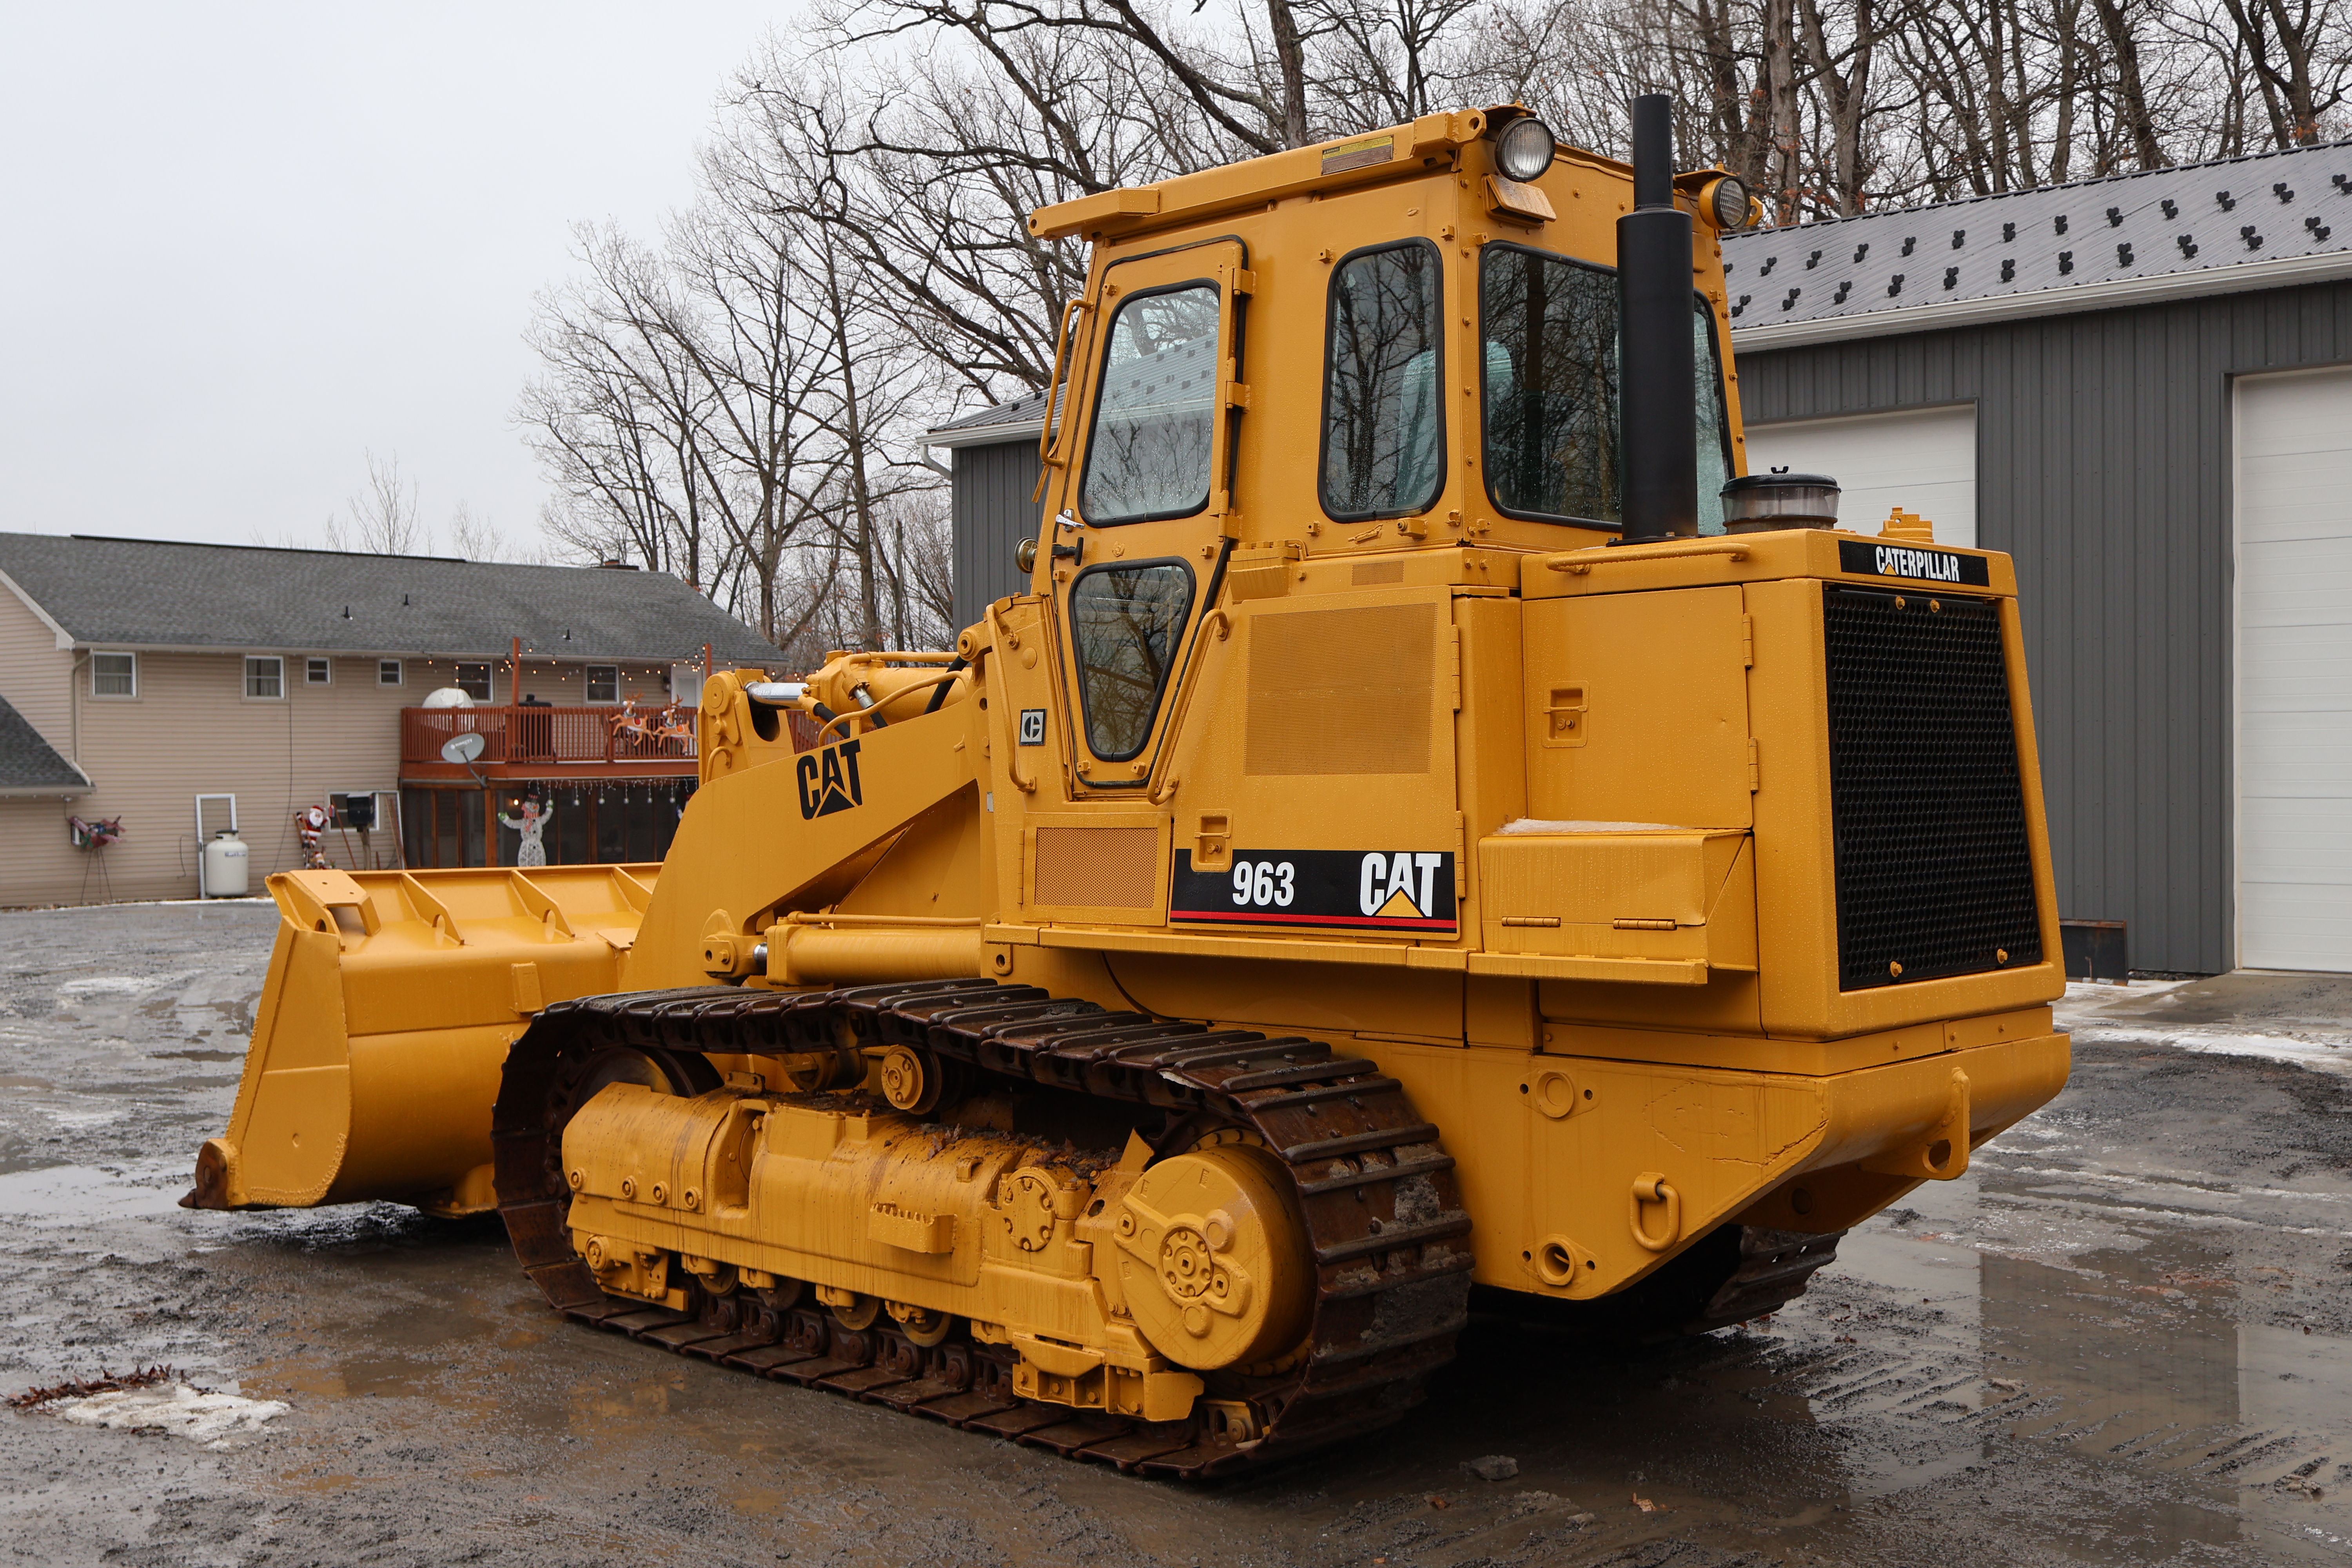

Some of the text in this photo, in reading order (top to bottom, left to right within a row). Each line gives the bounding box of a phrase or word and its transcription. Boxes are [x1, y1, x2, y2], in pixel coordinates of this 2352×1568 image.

[1876, 546, 1960, 582] CATERPILLAR
[797, 739, 863, 820] CAT
[1232, 852, 1441, 917] 963 CAT
